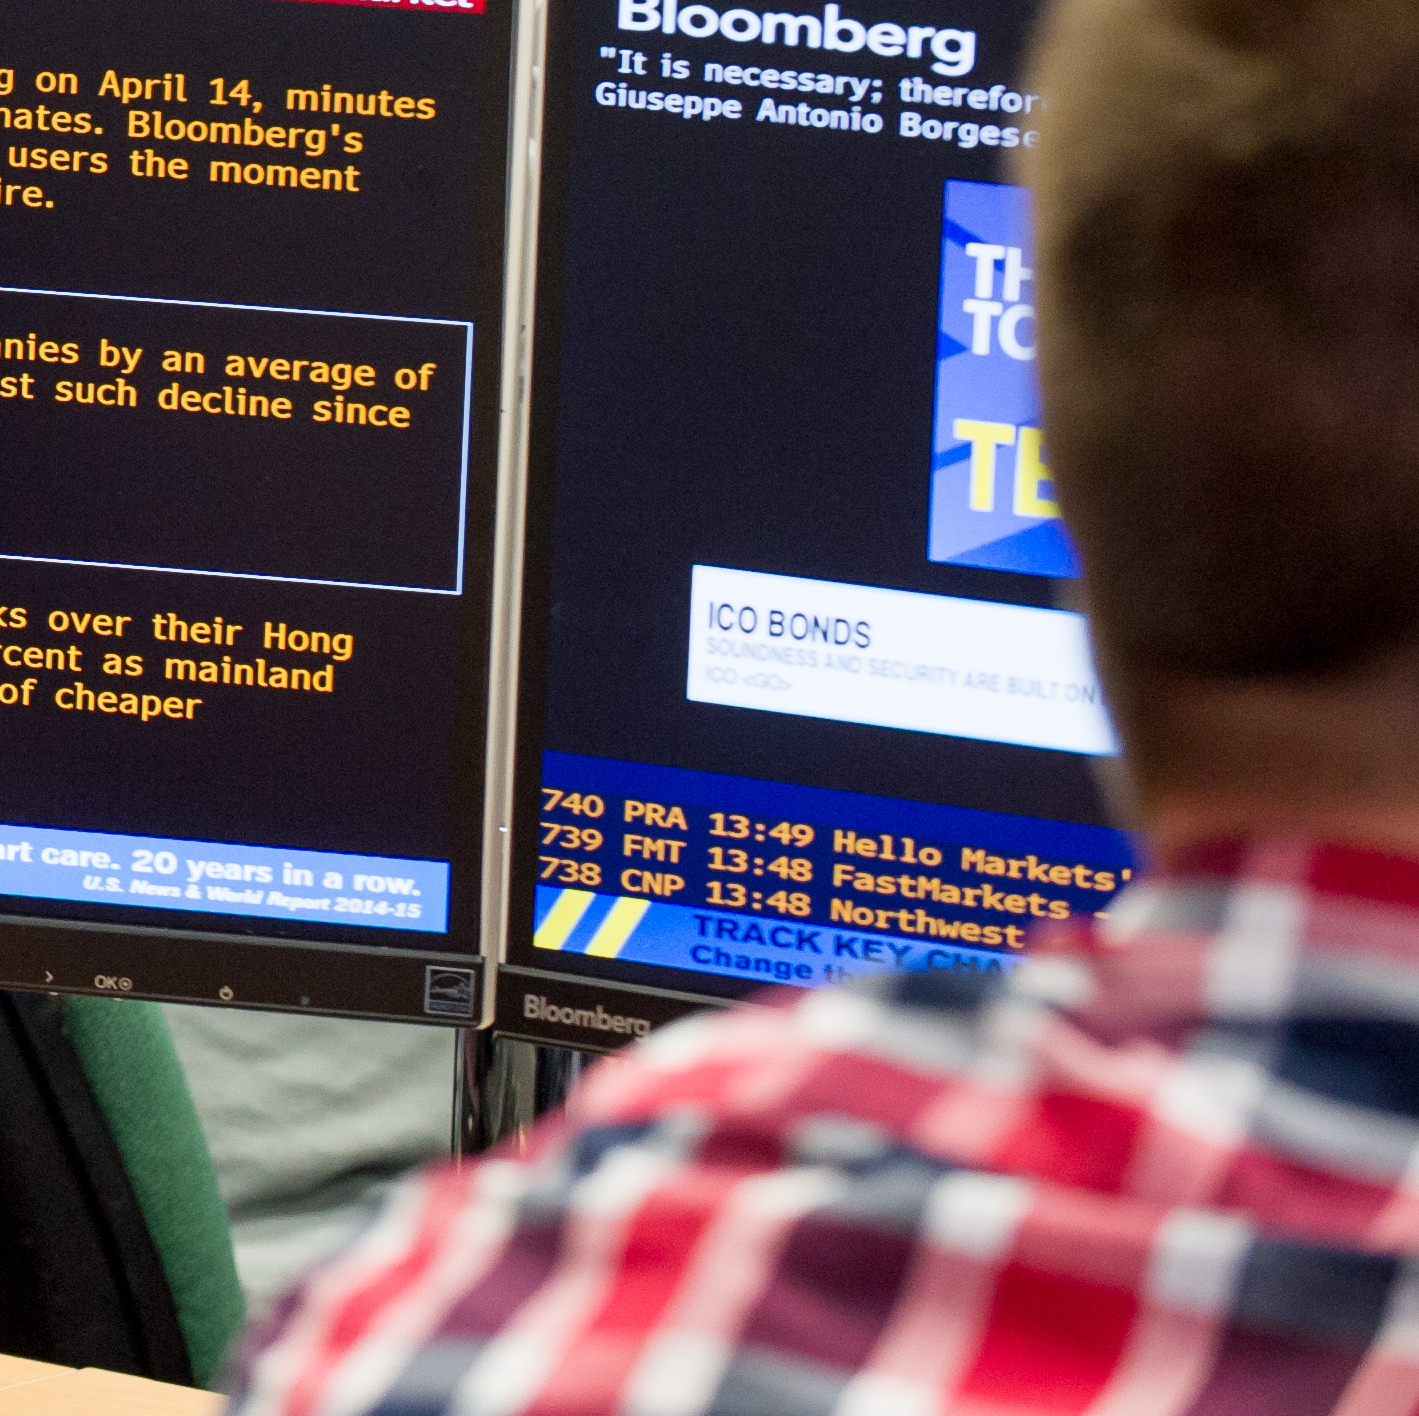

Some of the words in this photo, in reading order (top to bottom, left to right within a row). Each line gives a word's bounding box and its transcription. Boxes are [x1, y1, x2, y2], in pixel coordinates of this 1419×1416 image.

[35, 71, 78, 95] on
[97, 69, 188, 104] April
[209, 77, 263, 114] 14,
[286, 84, 436, 120] minutes
[595, 81, 743, 121] Giuseppe
[756, 97, 883, 134] Antonio
[600, 46, 648, 76] "It
[660, 52, 690, 79] is
[704, 63, 883, 104] necessary;
[897, 76, 1050, 117] therefor
[707, 601, 758, 634] ICO
[767, 609, 873, 650] BONDS
[705, 637, 819, 669] SOUNDNESS
[823, 651, 863, 675] AND
[868, 657, 960, 685] SECURITY
[963, 671, 1001, 691] ARE
[1006, 676, 1059, 698] BUILT
[541, 788, 605, 818] 740
[624, 799, 688, 830] PRA
[709, 812, 815, 848] 13:49
[833, 829, 942, 866] Hello
[961, 847, 1132, 891] Markets'
[40, 841, 122, 872] care.
[129, 847, 180, 876] 20
[184, 857, 274, 887] years
[281, 862, 314, 888] in
[322, 871, 344, 890] a
[352, 873, 423, 898] row.
[540, 821, 603, 851] 739
[623, 833, 687, 864] FMT
[707, 846, 813, 882] 13:48
[833, 863, 1070, 920] FastMarkets
[539, 855, 602, 886] 738
[620, 868, 685, 897] CNP
[705, 880, 811, 916] 13:48
[830, 898, 1025, 949] Northwest
[690, 943, 813, 983] Change
[693, 913, 822, 955] TRACK
[833, 933, 913, 968] KEY
